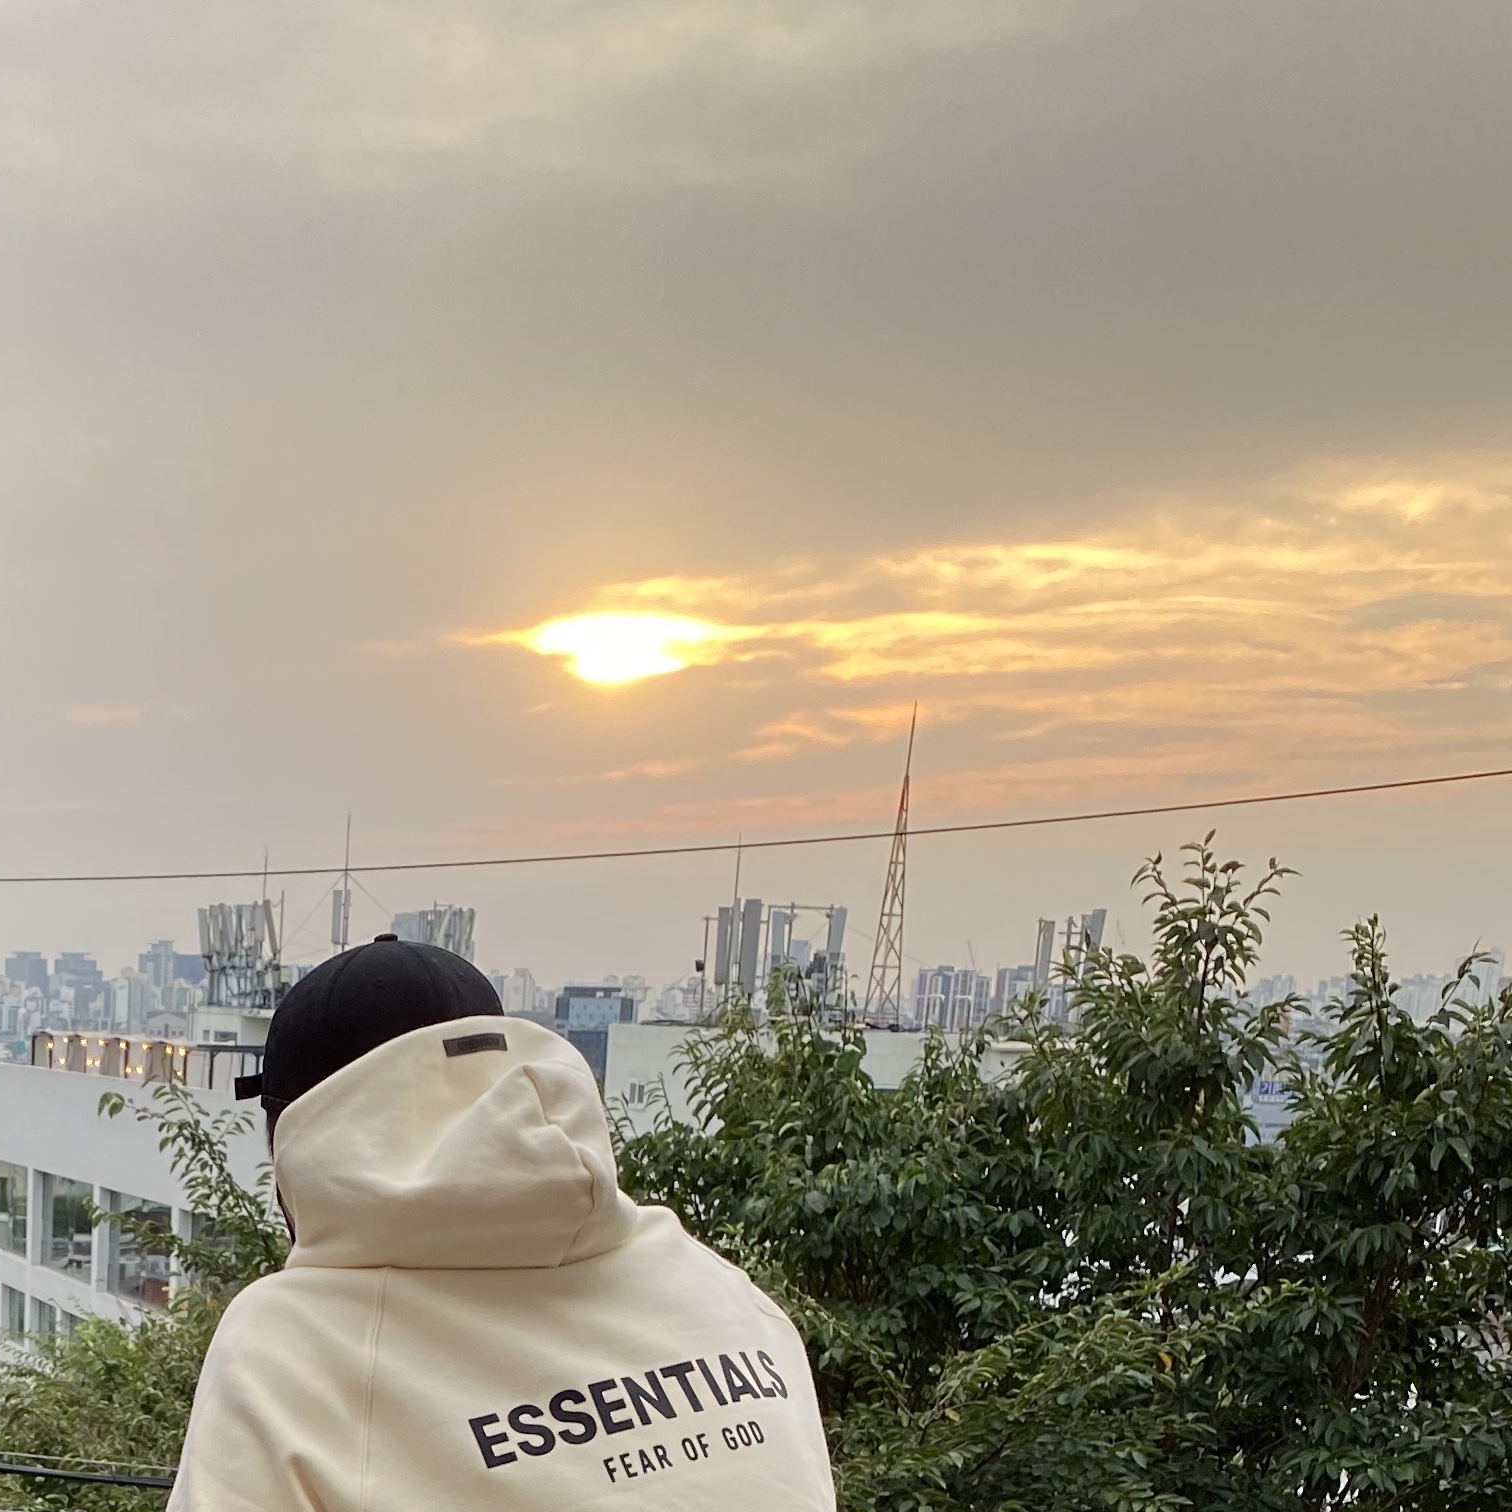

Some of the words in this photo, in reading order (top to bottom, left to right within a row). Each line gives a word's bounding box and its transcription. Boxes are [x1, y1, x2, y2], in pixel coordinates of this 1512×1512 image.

[468, 1350, 788, 1468] ESSENTIALS
[602, 1444, 673, 1483] FEAR
[681, 1433, 709, 1461] OF
[721, 1420, 765, 1451] GOD
